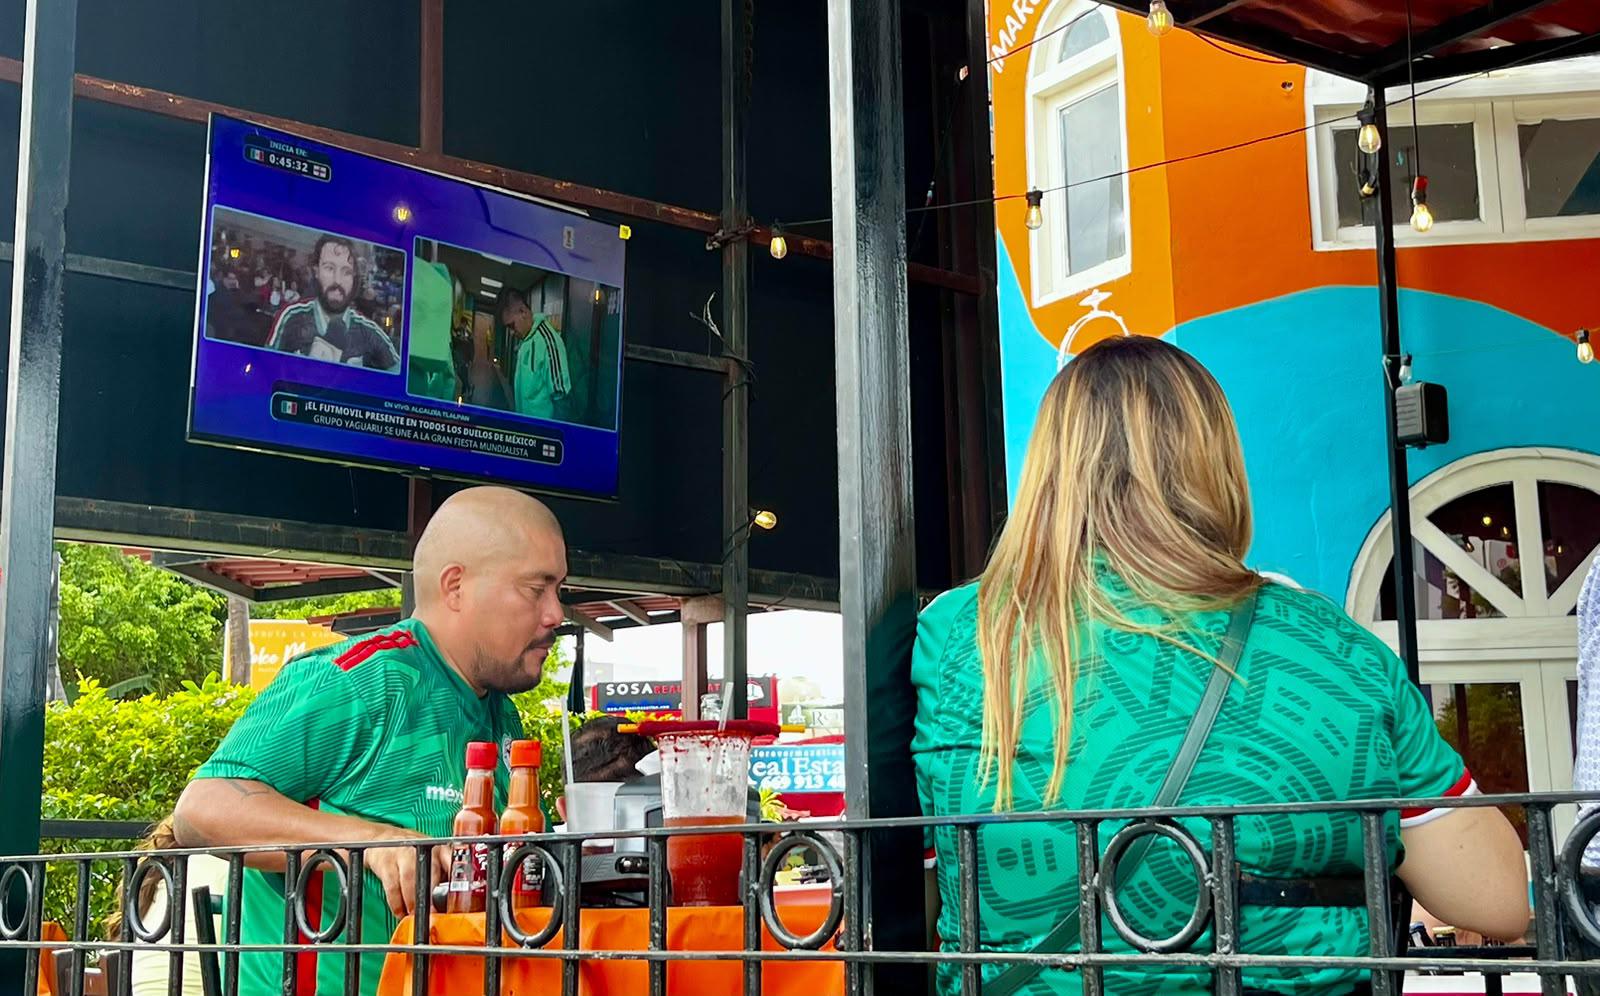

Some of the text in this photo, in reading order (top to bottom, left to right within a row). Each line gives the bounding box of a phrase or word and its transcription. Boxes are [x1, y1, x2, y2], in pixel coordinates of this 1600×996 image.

[270, 140, 294, 155] INICIA
[269, 154, 308, 172] 0:45:32
[305, 401, 537, 447] ¡EL FUTMOVIL PRESENTE EN TODOS LOS DUELOS DE MÉXICO!
[313, 414, 529, 457] GRUPO YAGUARU SE UNE A LA GRAN FIESTA MUNDIALISTA
[605, 683, 654, 696] SOSA
